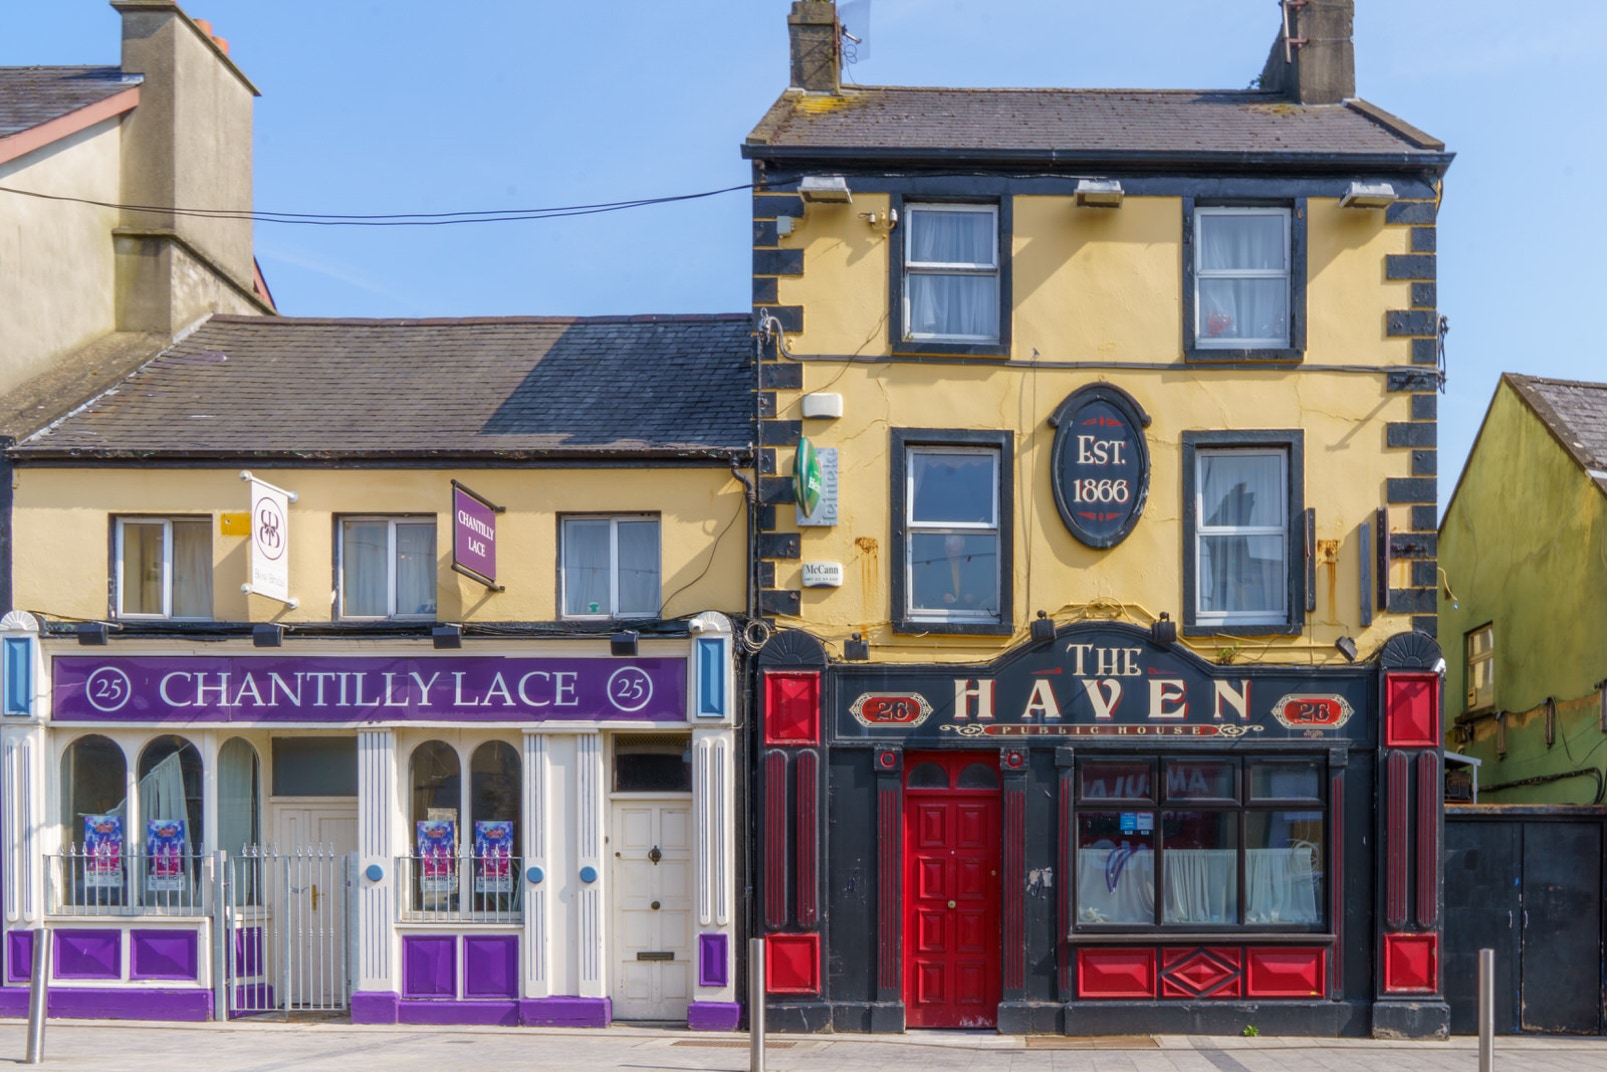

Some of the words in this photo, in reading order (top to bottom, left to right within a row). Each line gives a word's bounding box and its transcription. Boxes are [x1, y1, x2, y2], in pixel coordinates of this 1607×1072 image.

[1076, 435, 1127, 466] EST.
[1072, 478, 1130, 503] 1866
[457, 509, 495, 542] CHANTILLY
[468, 536, 486, 558] LACE
[805, 564, 839, 575] McCann
[1065, 643, 1143, 677] THE
[95, 678, 123, 700] 25
[159, 671, 440, 707] CHANTILLY
[451, 671, 579, 707] LACE
[617, 678, 645, 700] 25
[953, 678, 1253, 720] HAVEN
[876, 702, 912, 721] 26
[1299, 703, 1331, 722] 26
[1001, 726, 1100, 736] PUBLIC
[1117, 726, 1202, 736] HOUSE
